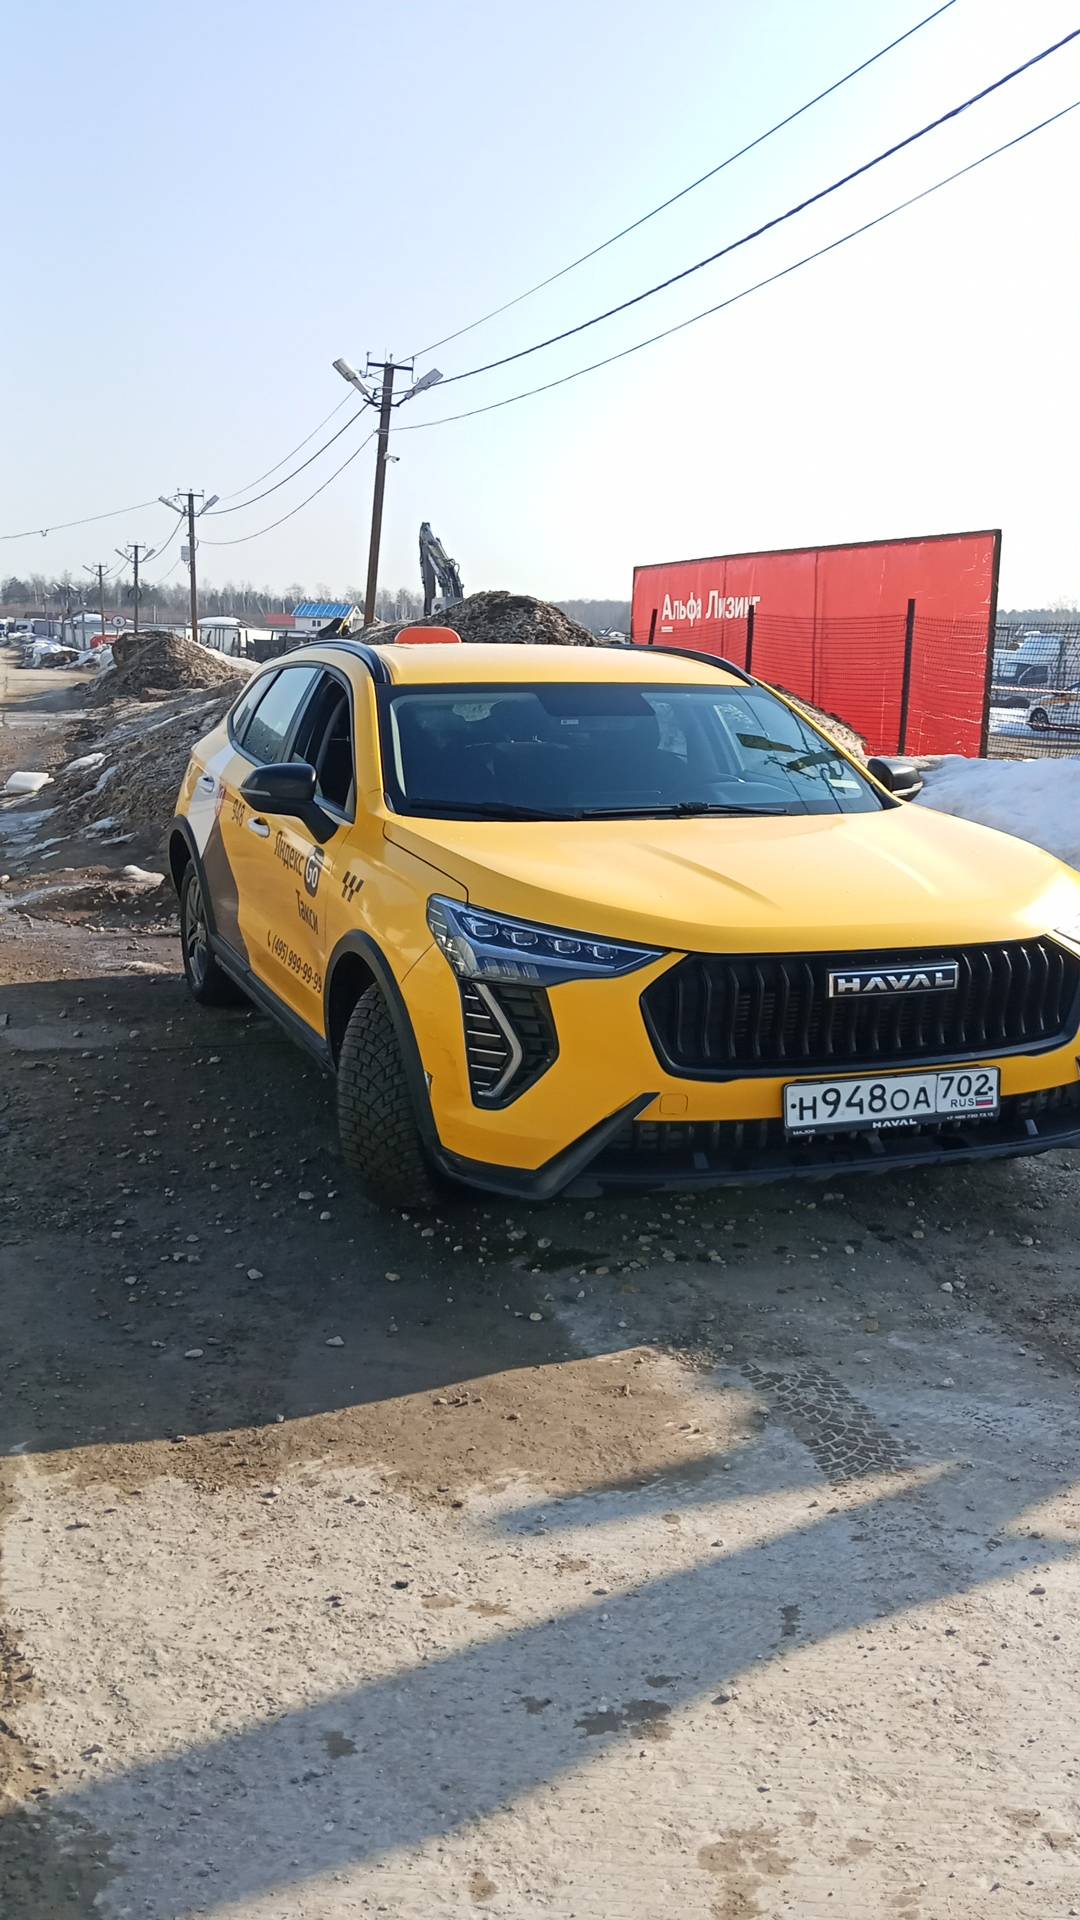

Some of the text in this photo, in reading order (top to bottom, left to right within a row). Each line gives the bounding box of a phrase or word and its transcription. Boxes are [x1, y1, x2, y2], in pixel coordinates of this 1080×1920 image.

[661, 592, 702, 627] Альфа
[274, 831, 304, 876] Яндекс
[296, 889, 319, 935] Такси
[271, 934, 322, 993] (495) 999-99-99
[837, 972, 954, 993] HAVAL
[940, 1074, 989, 1098] 702
[951, 1098, 974, 1109] RUS
[872, 1118, 917, 1129] HAVAL
